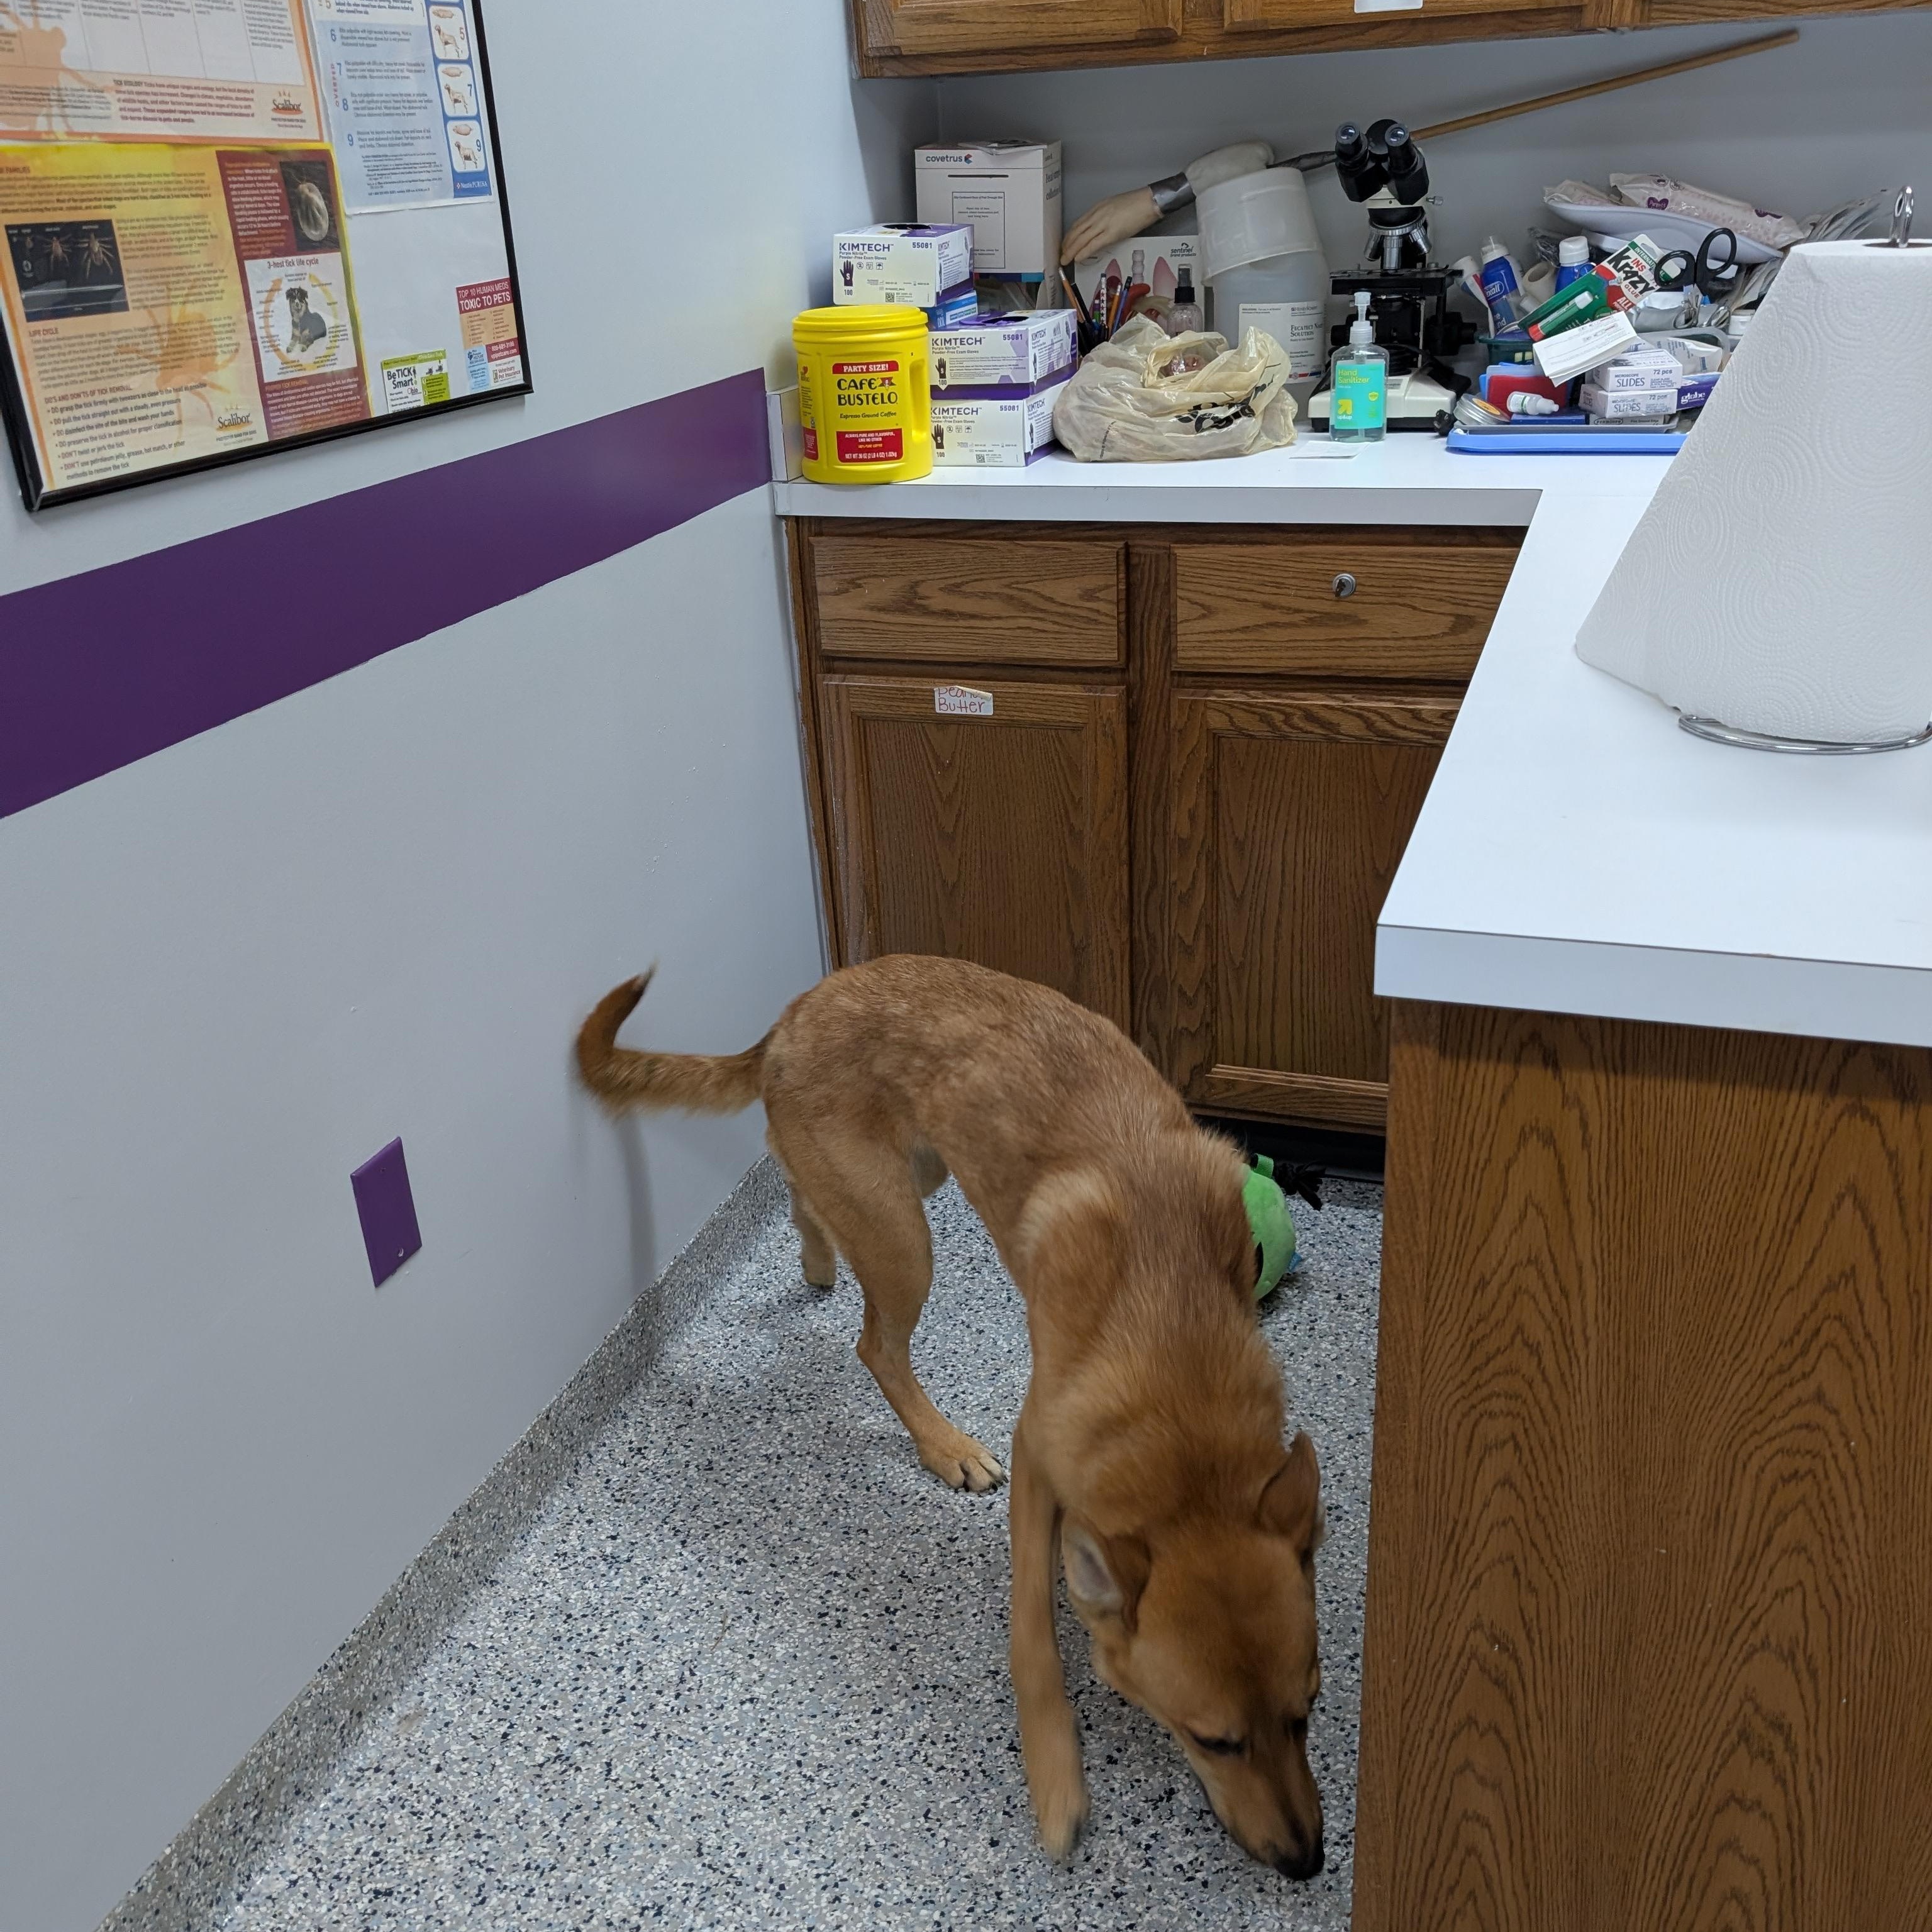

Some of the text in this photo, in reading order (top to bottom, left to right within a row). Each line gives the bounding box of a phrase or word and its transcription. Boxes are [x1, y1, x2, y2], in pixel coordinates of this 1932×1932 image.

[330, 29, 336, 42] 6
[459, 27, 465, 40] 5
[336, 63, 342, 75] 7
[467, 84, 472, 97] 7
[342, 98, 348, 111] 8
[348, 133, 353, 146] 9
[476, 139, 482, 152] 9
[925, 154, 963, 162] covetrus
[458, 281, 509, 299] TOP 10 HUMAN MEDS
[1624, 284, 1640, 299] GLUE
[460, 291, 511, 311] TOXIC TO PETS
[387, 366, 413, 380] BeTICK
[1338, 369, 1358, 377] Hand
[392, 377, 414, 389] Smart
[1616, 377, 1645, 387] SLIDES
[837, 392, 898, 406] BUSTELO
[1680, 392, 1706, 404] globe
[218, 413, 251, 429] Scalibor
[938, 697, 985, 713] Butter
